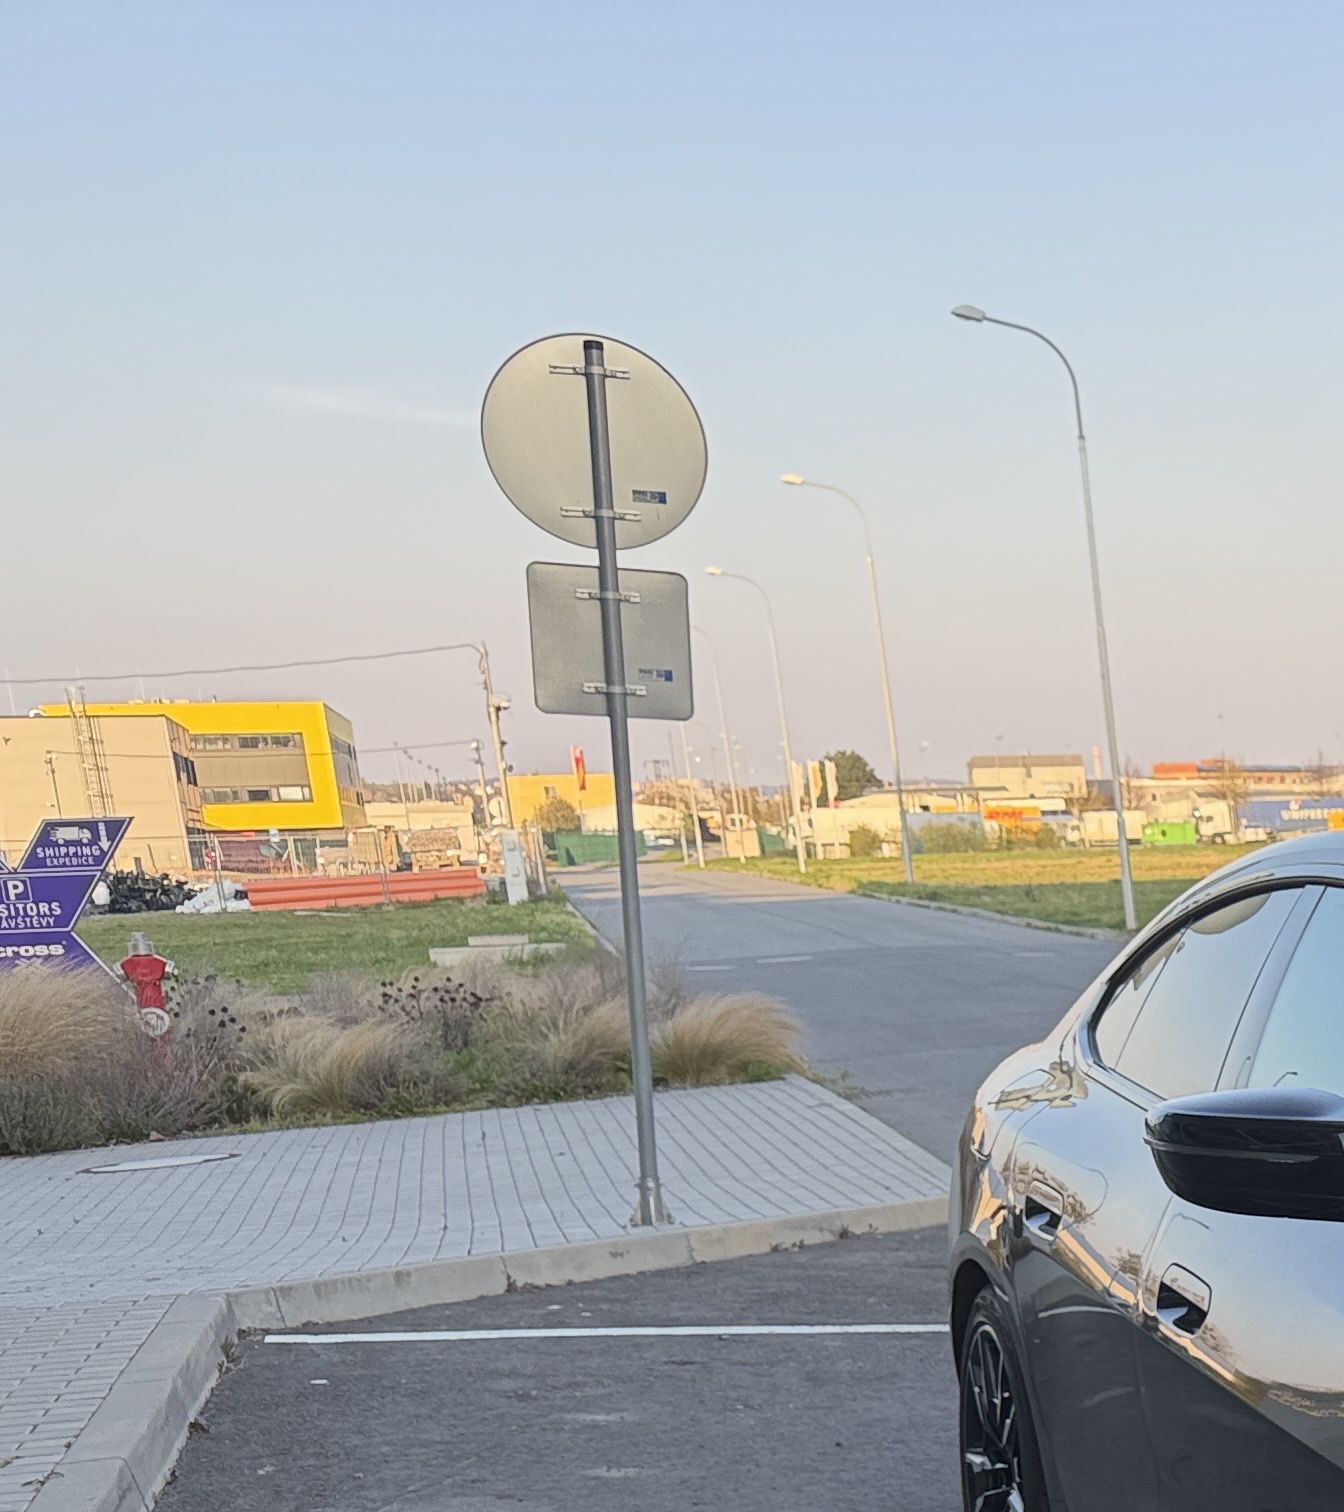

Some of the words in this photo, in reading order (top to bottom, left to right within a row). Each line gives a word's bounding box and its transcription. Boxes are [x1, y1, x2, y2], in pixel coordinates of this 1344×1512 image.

[36, 845, 100, 858] SHIPPING
[46, 856, 95, 867] EXPEDICE
[7, 880, 24, 901] P
[0, 902, 61, 916] SITORS
